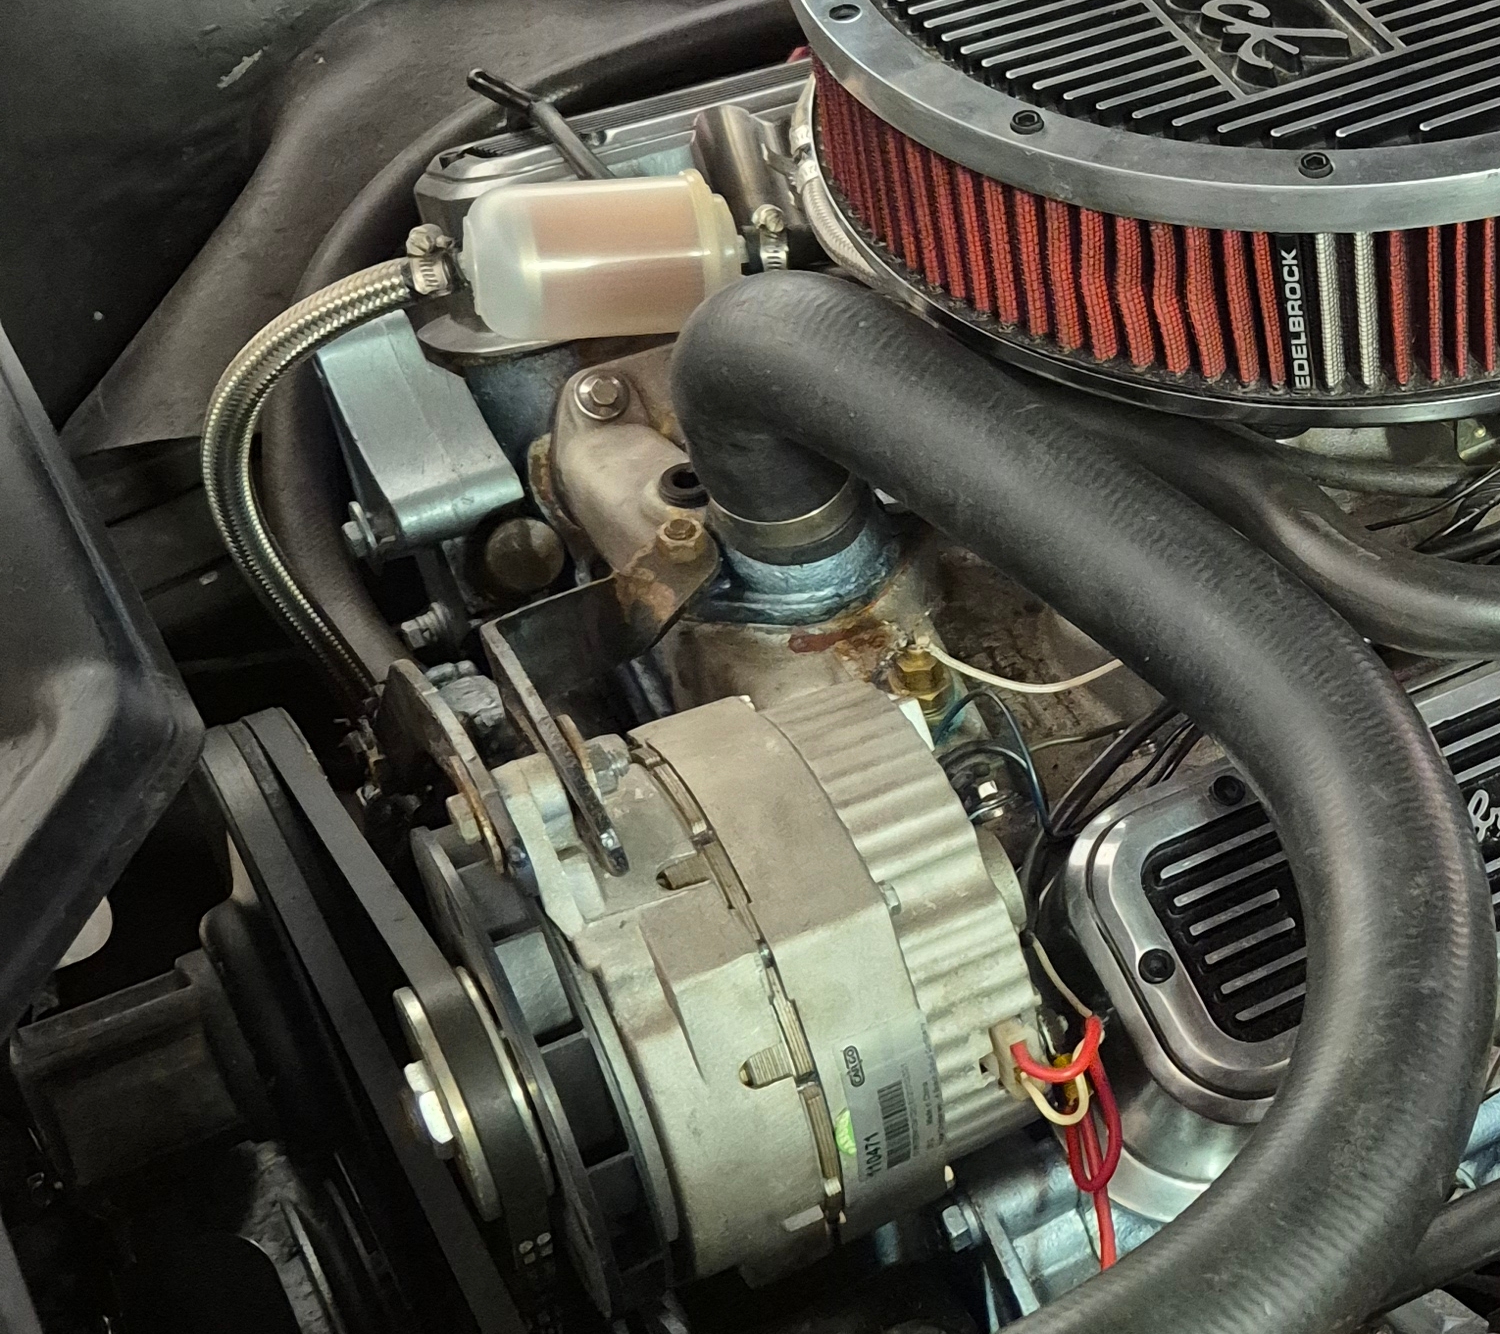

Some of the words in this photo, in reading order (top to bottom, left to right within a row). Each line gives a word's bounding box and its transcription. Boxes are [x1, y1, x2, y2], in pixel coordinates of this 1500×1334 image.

[1280, 248, 1312, 390] EDELBROCK
[844, 1046, 864, 1086] CARGO
[863, 1131, 883, 1177] 110471
